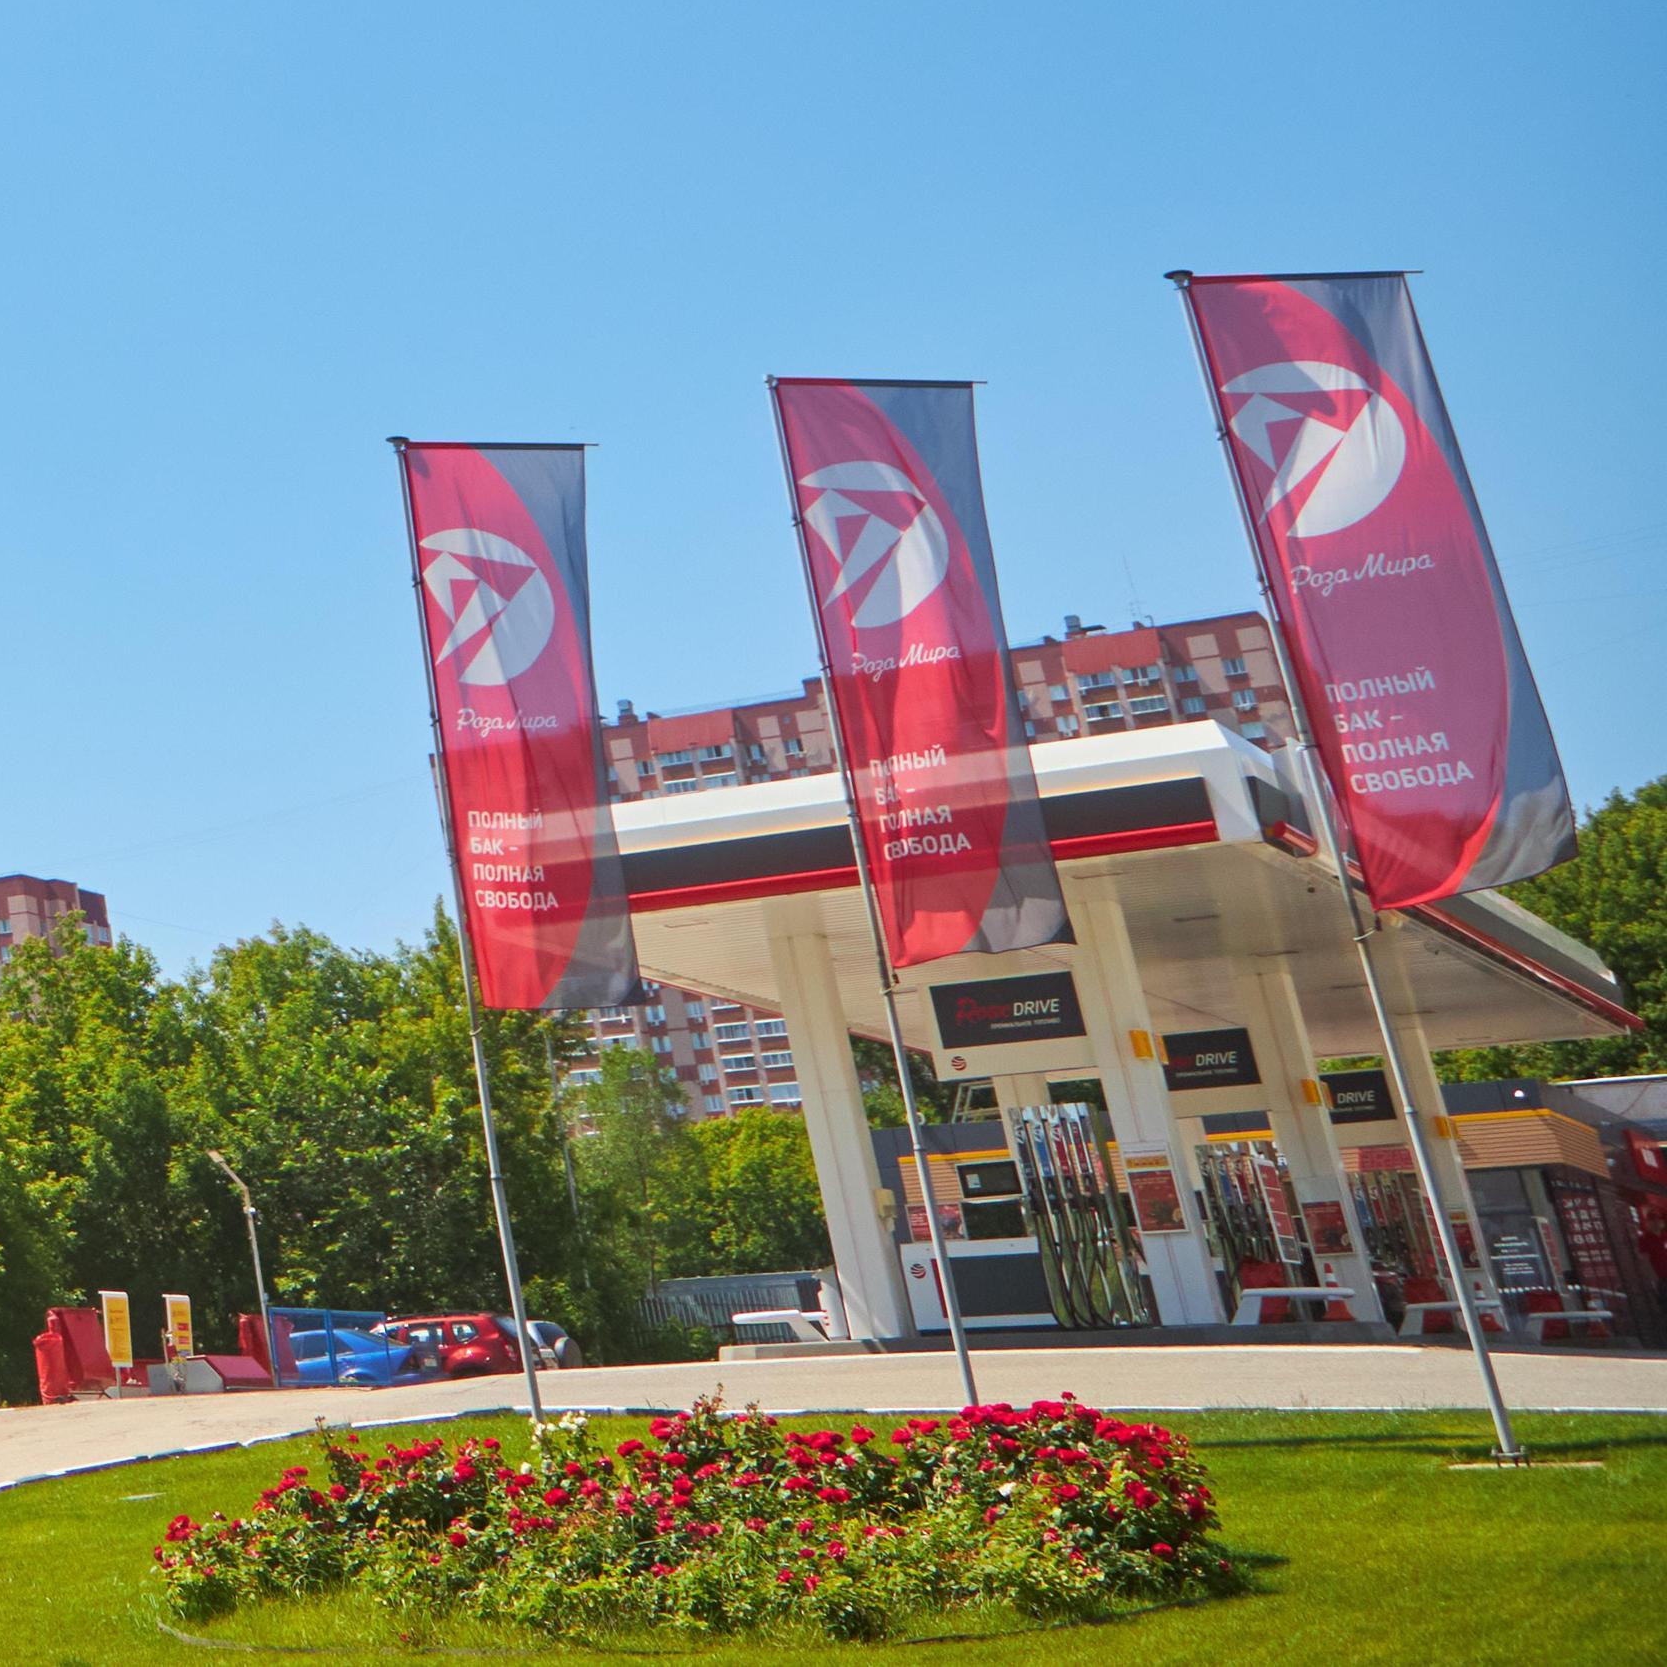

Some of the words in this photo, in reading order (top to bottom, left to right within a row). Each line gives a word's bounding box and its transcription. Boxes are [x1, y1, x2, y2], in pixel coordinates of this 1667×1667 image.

[1291, 564, 1351, 597] Роза
[1354, 552, 1435, 581] Мира
[899, 642, 961, 669] Мира
[1324, 665, 1436, 704] ПОЛНЫЙ
[457, 708, 504, 738] Роза
[1333, 709, 1384, 734] БАК
[1341, 731, 1451, 764] ПОЛНАЯ
[1350, 760, 1475, 795] СВОБОДА
[468, 808, 544, 830] ПОЛНЫЙ
[470, 836, 505, 856] БАК
[473, 862, 545, 883] ПОЛНАЯ
[475, 888, 559, 912] СВОБОДА
[1013, 998, 1060, 1017] DRIVE
[1195, 1050, 1238, 1067] DRIVE
[1337, 1090, 1376, 1104] DRIVE
